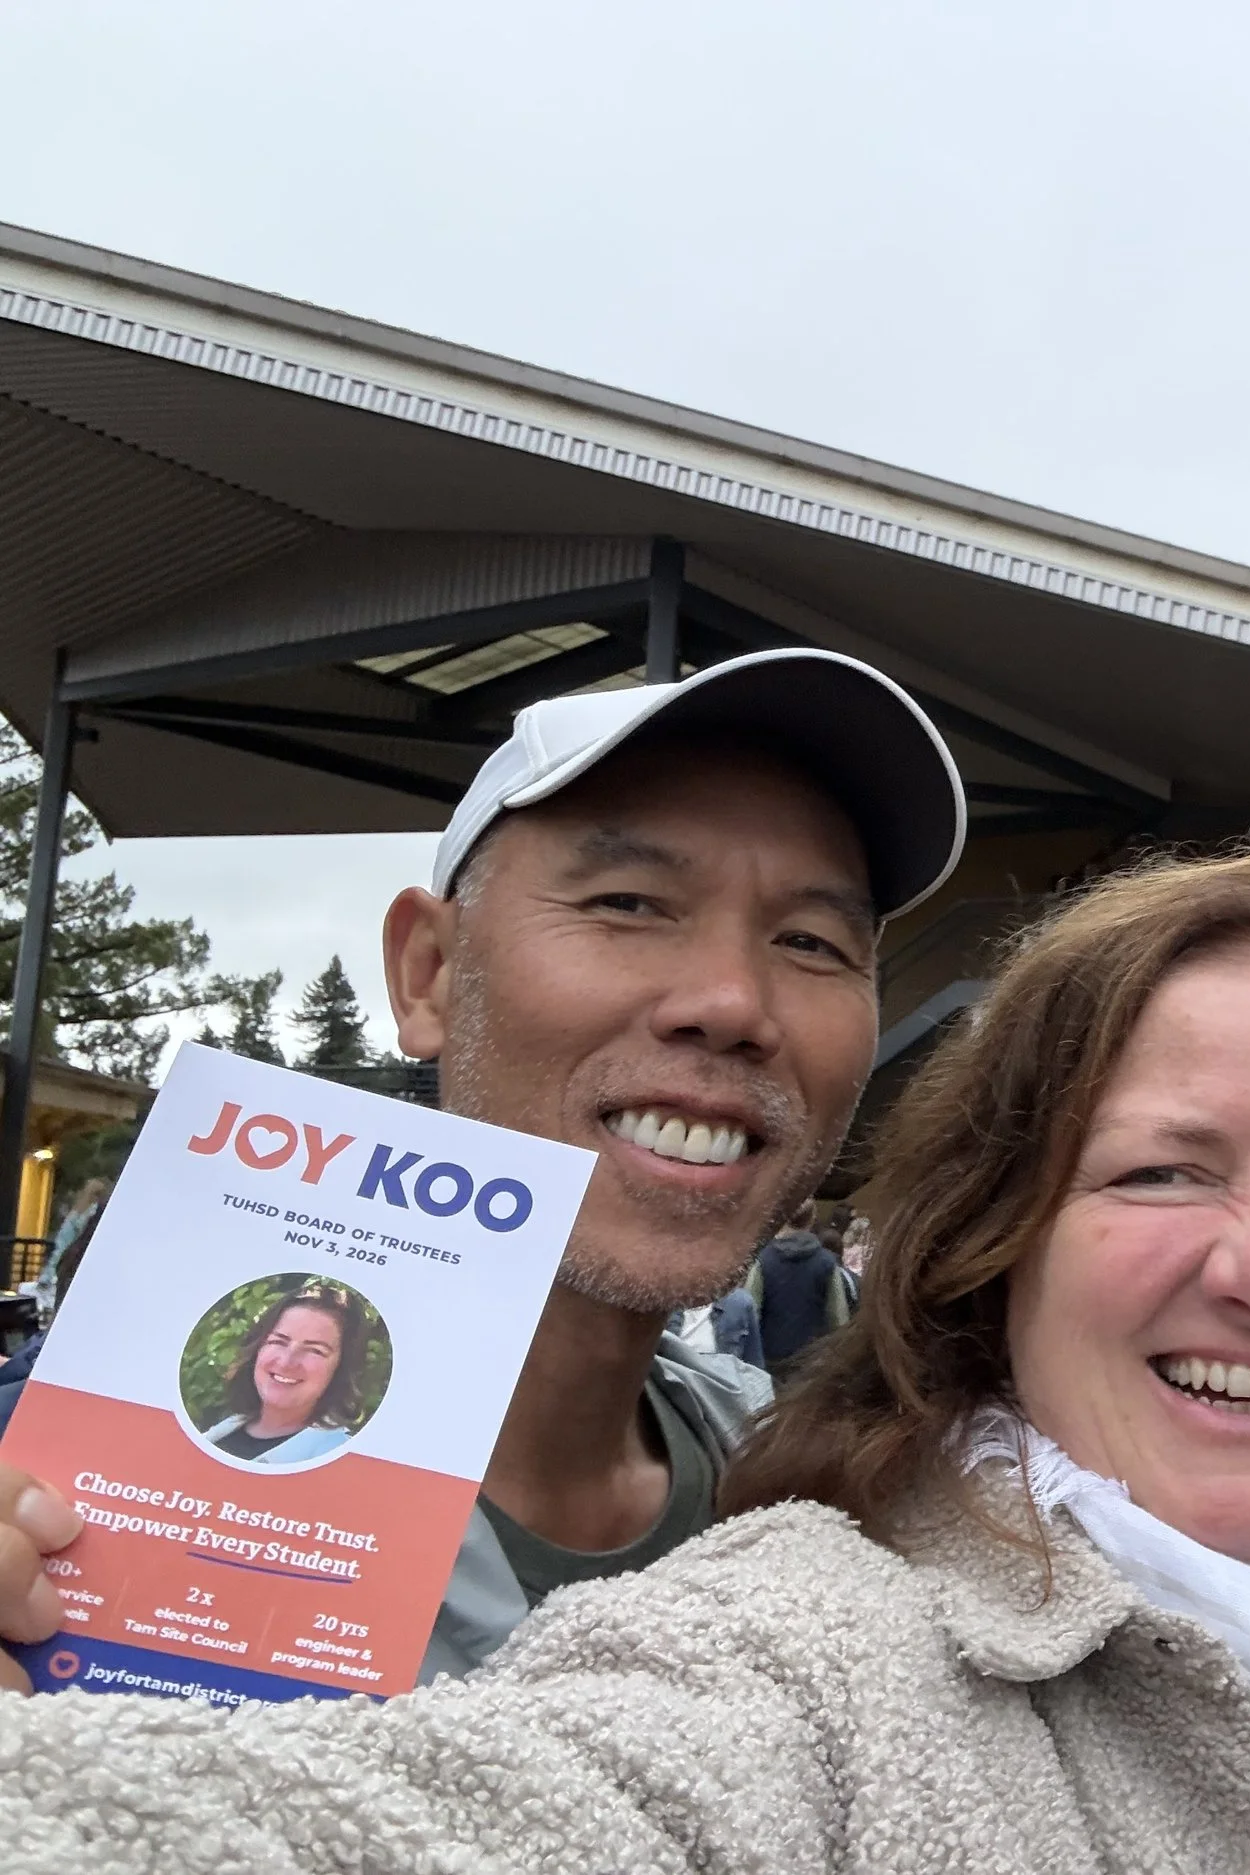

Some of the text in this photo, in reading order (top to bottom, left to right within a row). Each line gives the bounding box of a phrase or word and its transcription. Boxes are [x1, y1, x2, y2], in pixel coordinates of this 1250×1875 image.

[187, 1100, 534, 1233] JOY KOO
[223, 1193, 462, 1265] TUHSD BOARD OF TRUSTEES
[283, 1230, 388, 1266] NOV 3, 2026
[74, 1471, 379, 1552] Choose Joy. Restore Trust.
[74, 1500, 362, 1579] Empower Every Student.
[46, 1558, 82, 1577] 00+
[58, 1587, 104, 1606] ervice
[124, 1618, 249, 1654] Tam Site Council
[154, 1607, 230, 1632] elected to
[312, 1613, 370, 1638] 20 yrs
[294, 1637, 373, 1661] engineer &
[270, 1651, 384, 1681] program leader
